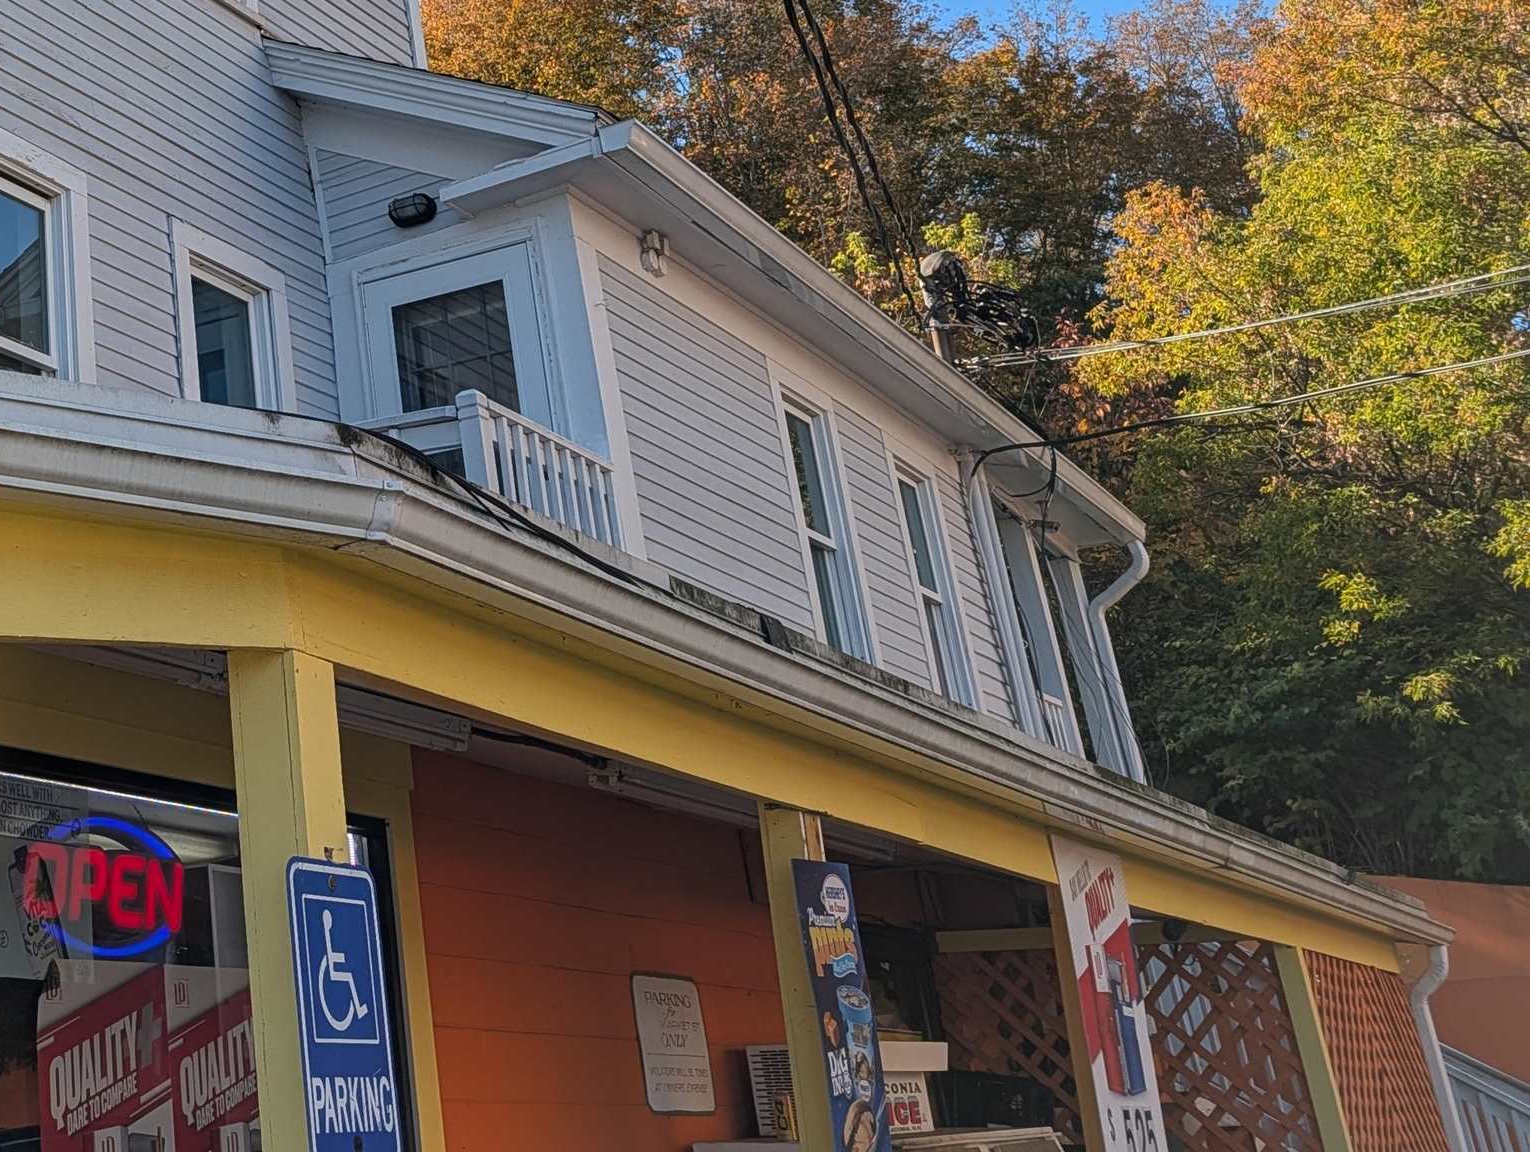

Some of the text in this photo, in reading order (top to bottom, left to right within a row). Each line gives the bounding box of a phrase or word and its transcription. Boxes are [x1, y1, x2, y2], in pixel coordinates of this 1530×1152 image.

[8, 782, 31, 798] WELL
[32, 786, 54, 803] WITH
[23, 844, 185, 932] OPEN
[644, 991, 691, 1009] PARKING
[661, 1032, 688, 1048] ONLY
[196, 1073, 257, 1131] DARE TO COMPARE
[885, 1081, 922, 1095] CONIA
[67, 1072, 138, 1136] DARE TO COMPARE
[312, 1076, 393, 1134] PARKING
[886, 1096, 921, 1127] ICE
